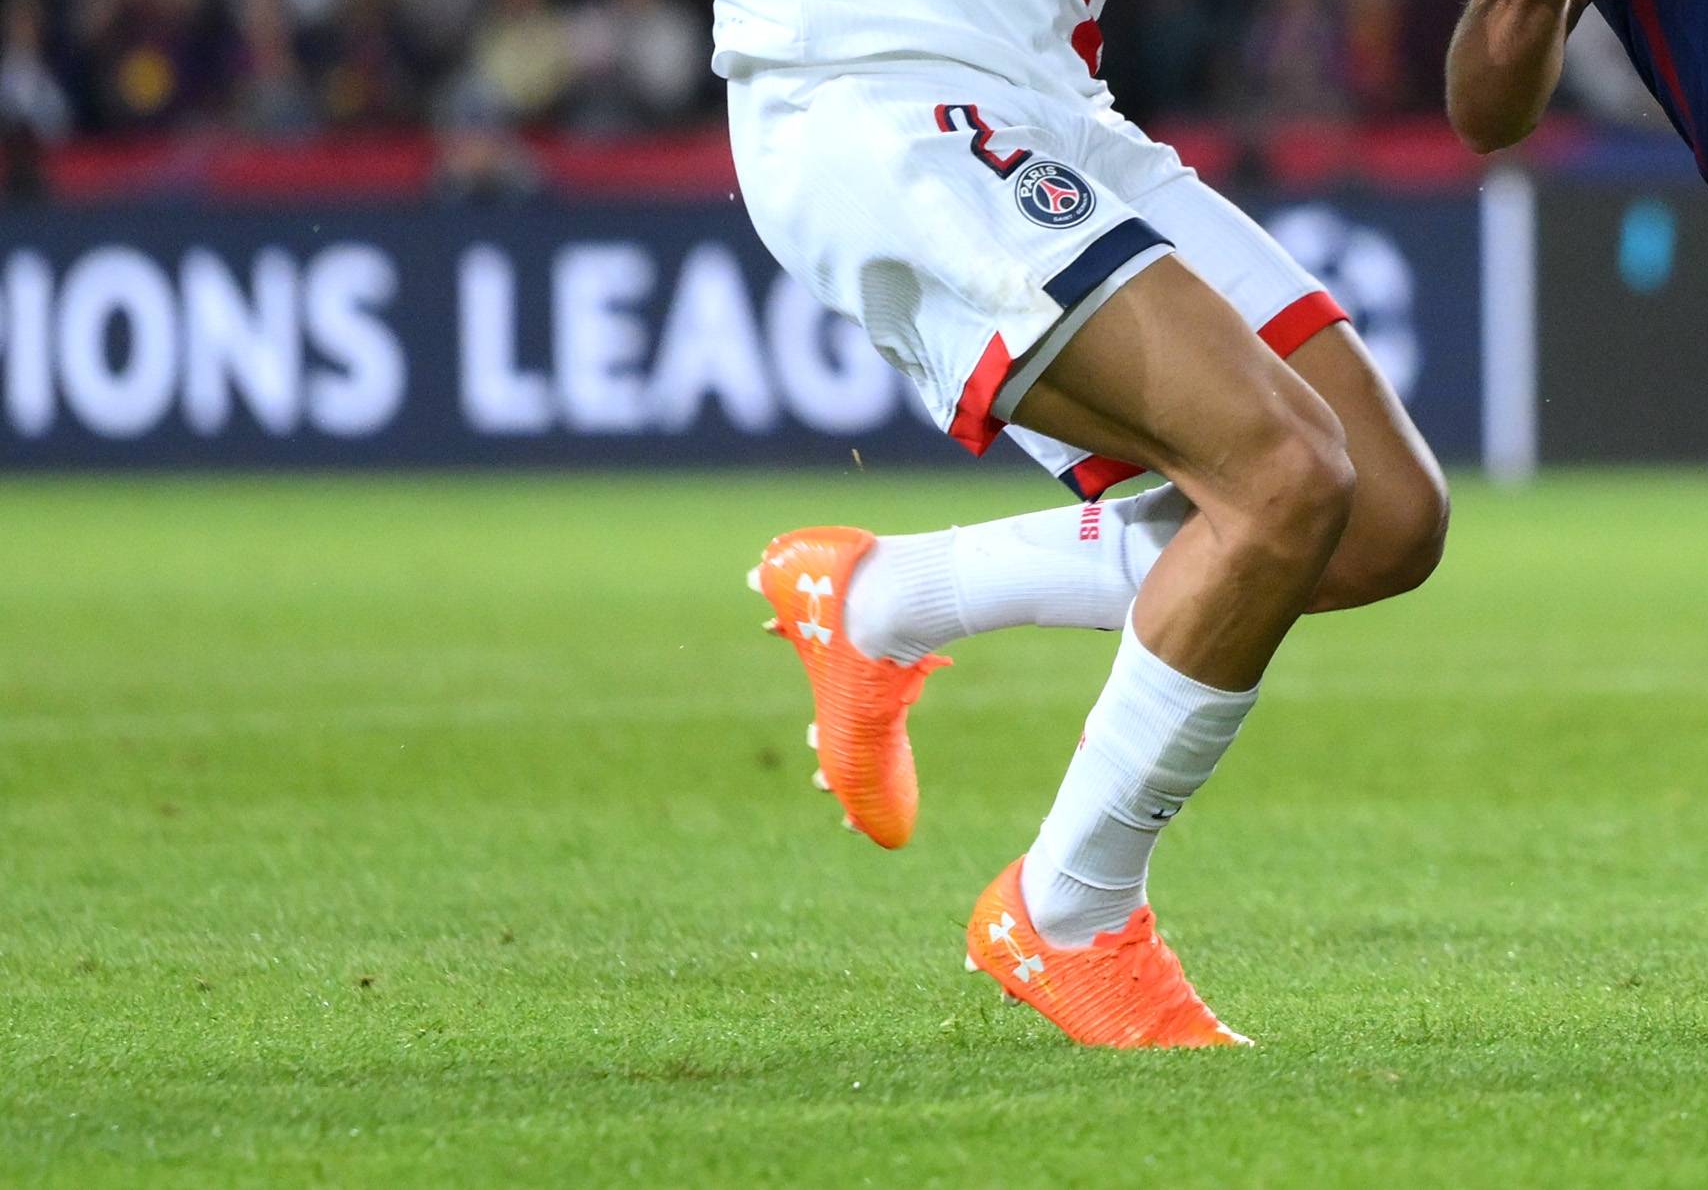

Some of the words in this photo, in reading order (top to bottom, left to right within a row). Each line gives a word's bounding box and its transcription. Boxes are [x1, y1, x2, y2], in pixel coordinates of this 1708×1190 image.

[934, 103, 1034, 181] 2
[1020, 165, 1058, 198] PARIS
[0, 244, 406, 438] IONS
[457, 240, 905, 436] LEAG
